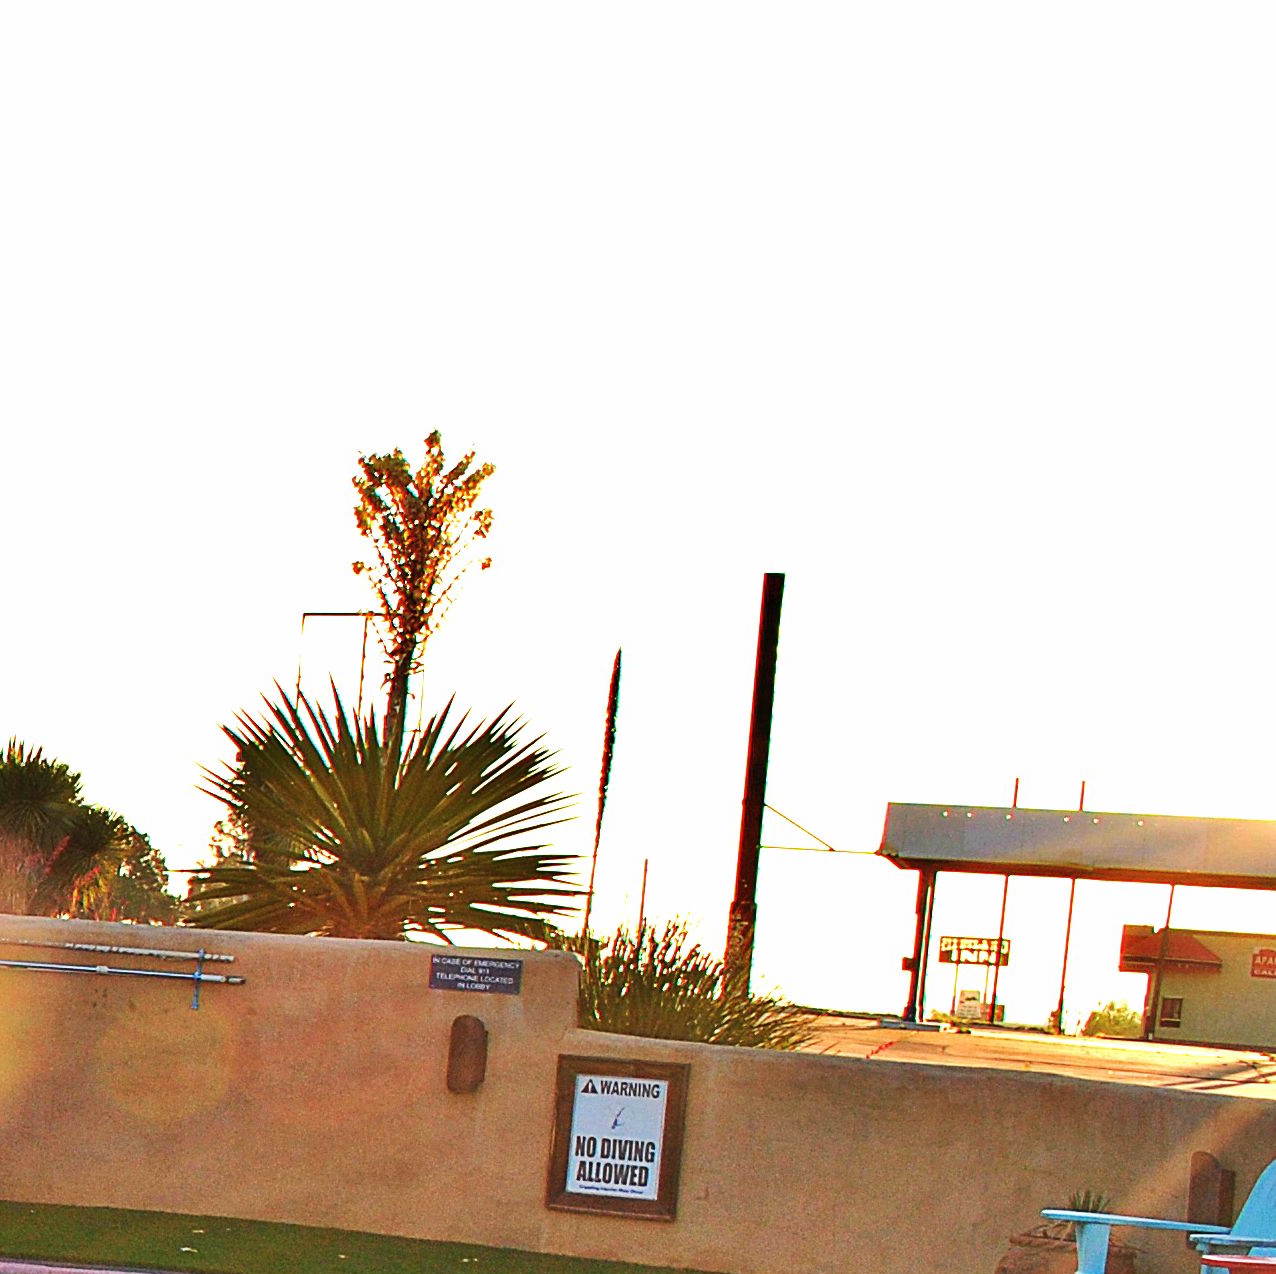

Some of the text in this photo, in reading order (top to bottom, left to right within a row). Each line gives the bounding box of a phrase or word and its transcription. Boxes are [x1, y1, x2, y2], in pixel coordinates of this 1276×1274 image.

[441, 957, 460, 965] CASE
[462, 958, 472, 966] OF
[474, 959, 520, 969] EMERGENCY
[460, 966, 476, 974] DIAL
[435, 972, 514, 984] TELEPHONE LOCATED
[466, 982, 491, 990] LOBBY
[600, 1080, 660, 1099] WARNING
[575, 1135, 656, 1163] NO DIVING
[576, 1160, 650, 1187] ALLOWED
